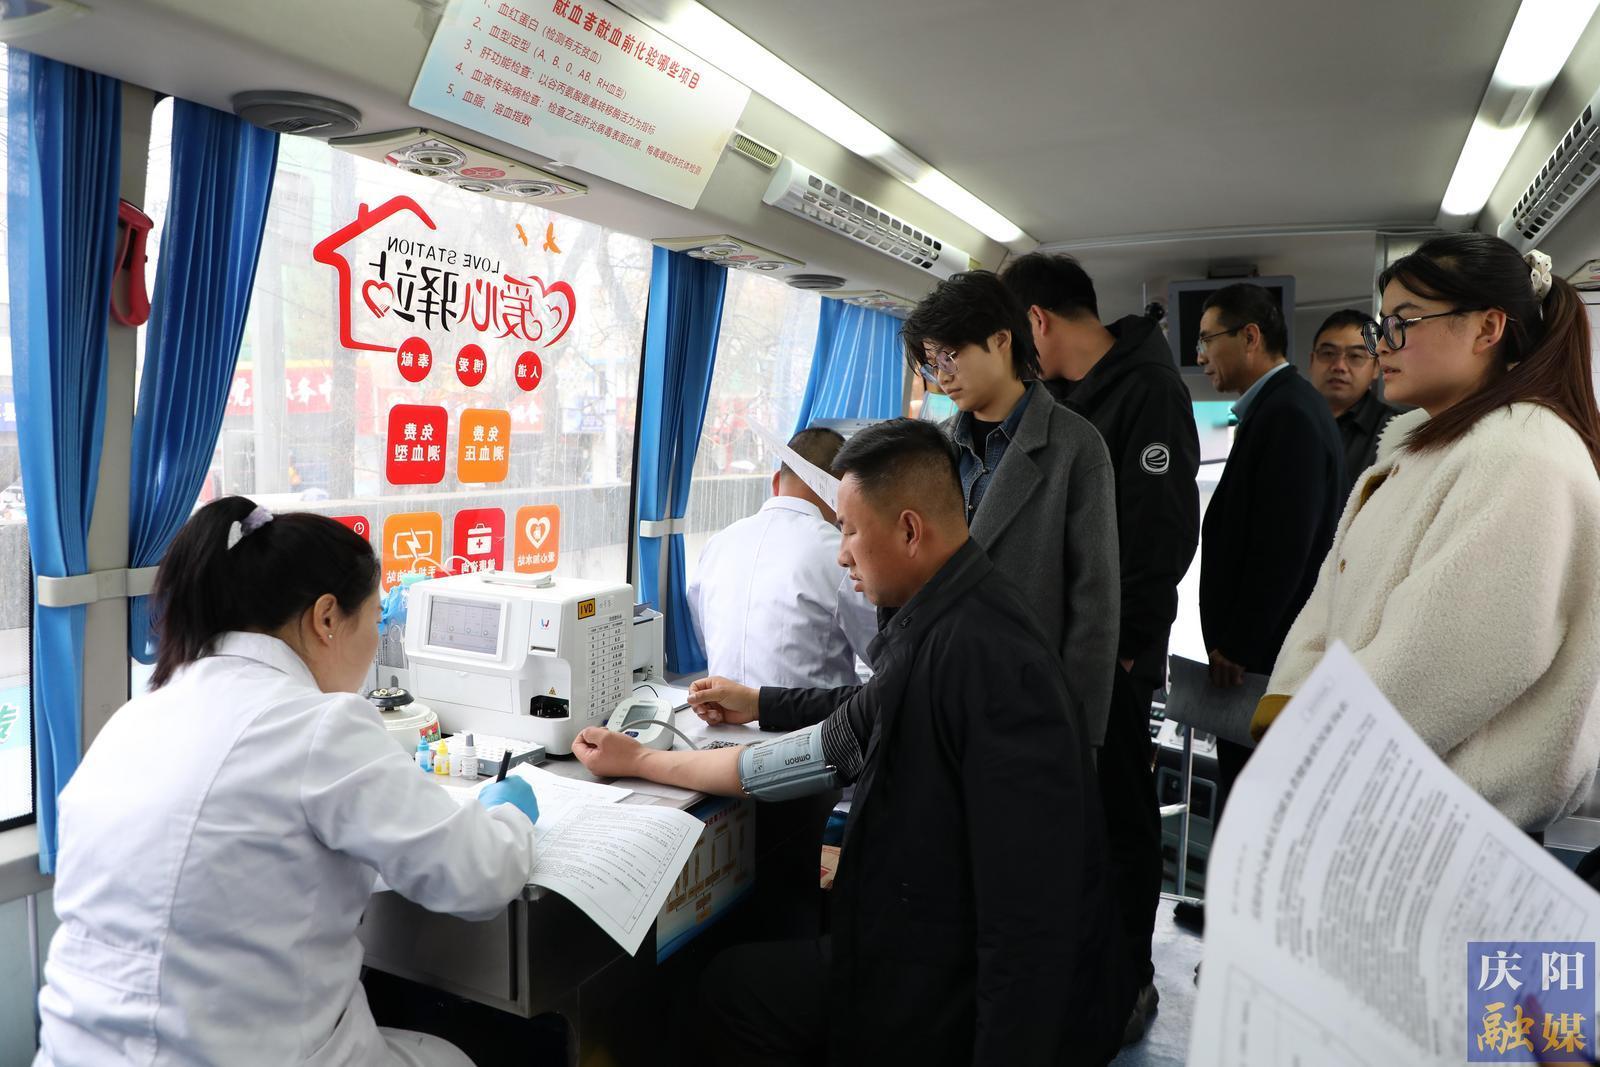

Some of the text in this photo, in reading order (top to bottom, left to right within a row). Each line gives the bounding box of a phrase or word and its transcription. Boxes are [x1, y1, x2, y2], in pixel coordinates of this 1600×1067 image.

[552, 0, 700, 89] 献血者献血前化验哪些项目
[580, 603, 594, 615] IVD
